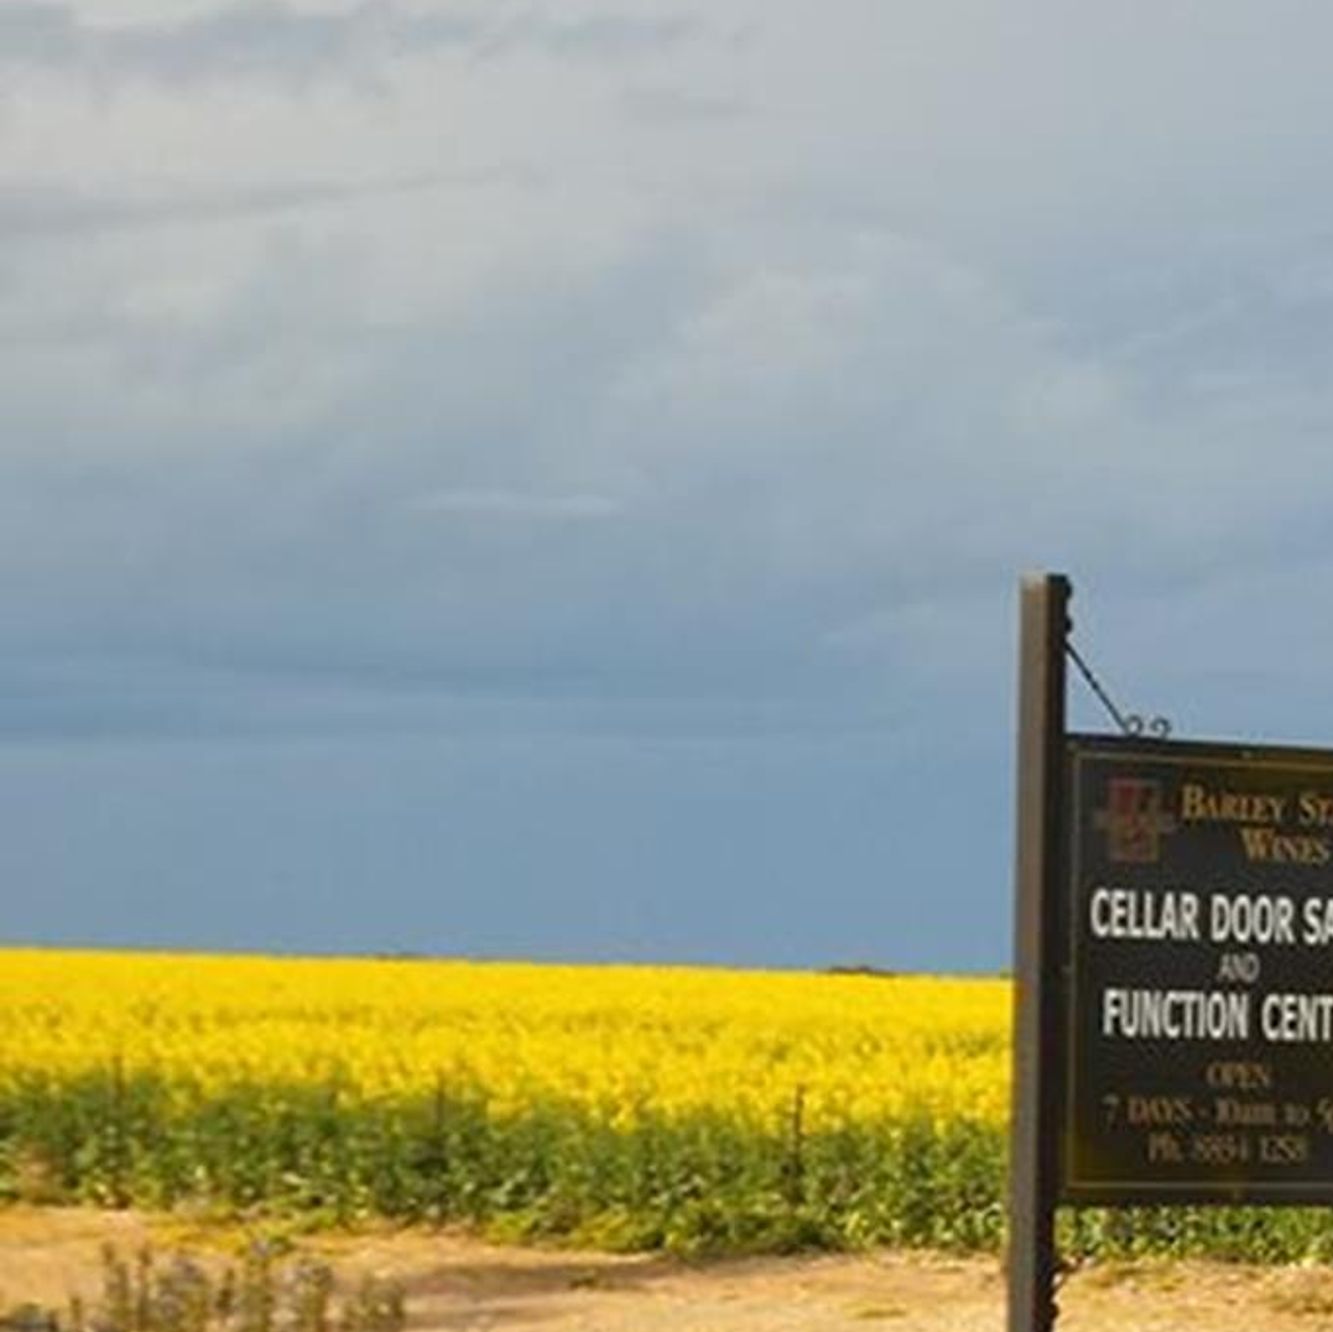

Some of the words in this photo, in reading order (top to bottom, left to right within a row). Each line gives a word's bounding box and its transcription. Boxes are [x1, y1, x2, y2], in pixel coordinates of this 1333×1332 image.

[1091, 889, 1200, 939] CELLAR
[1211, 895, 1296, 943] DOOR
[1217, 953, 1260, 982] AND
[1102, 989, 1249, 1038] FUNCTION
[1206, 1061, 1272, 1089] OPEN
[1127, 1096, 1193, 1125] DAYS
